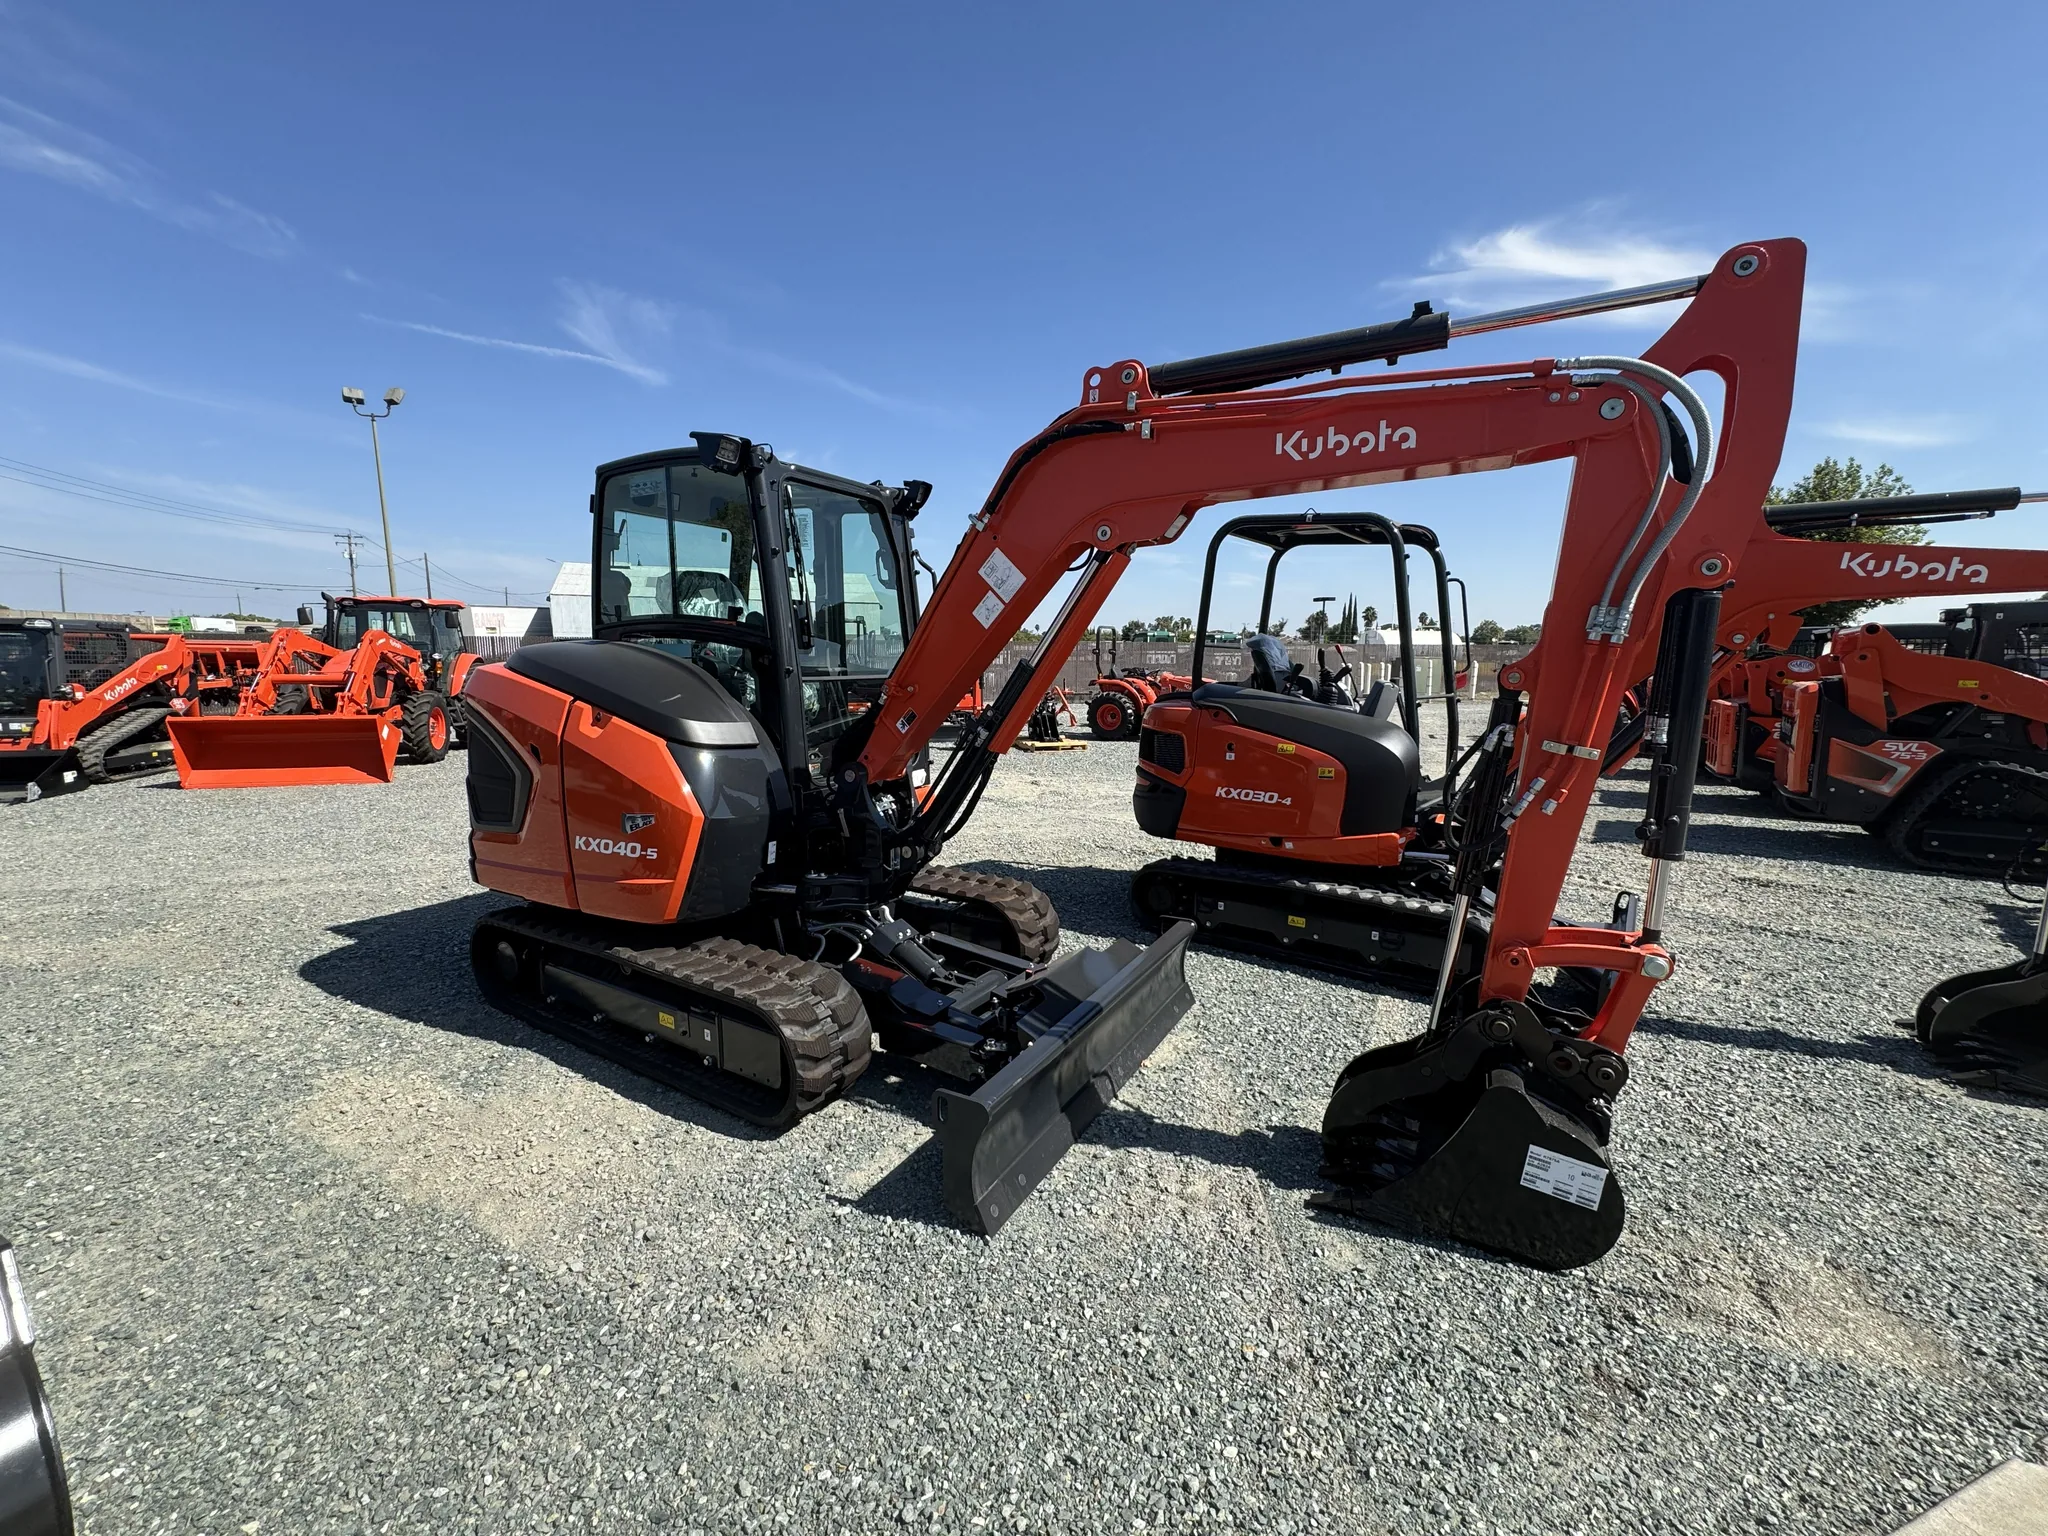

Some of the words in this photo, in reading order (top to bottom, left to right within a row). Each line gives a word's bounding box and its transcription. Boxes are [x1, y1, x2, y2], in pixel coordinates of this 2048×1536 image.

[1275, 419, 1417, 461] Kubota
[1839, 551, 1989, 584] Kubota
[103, 677, 137, 701] Kubota
[1881, 742, 1925, 752] SVL
[1890, 751, 1928, 760] 75-3
[1215, 786, 1292, 805] KX030-4
[575, 835, 658, 860] KX040-5
